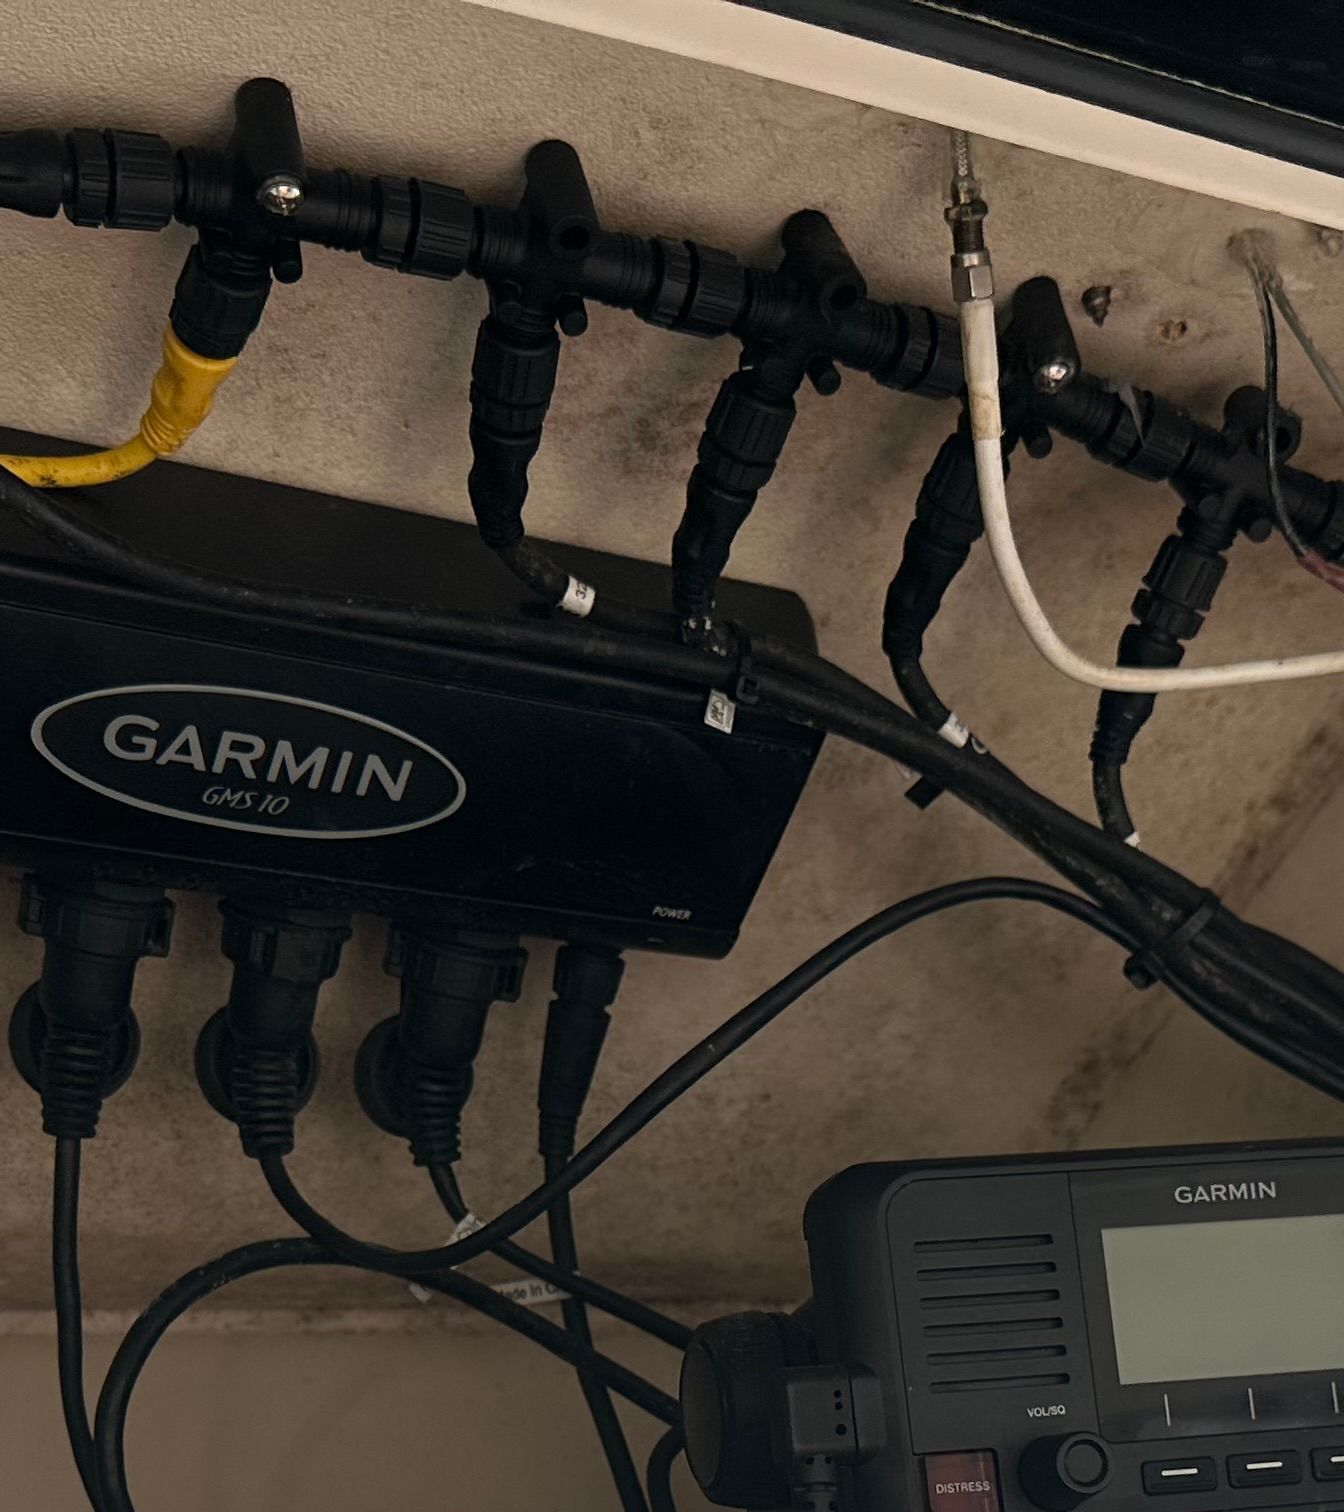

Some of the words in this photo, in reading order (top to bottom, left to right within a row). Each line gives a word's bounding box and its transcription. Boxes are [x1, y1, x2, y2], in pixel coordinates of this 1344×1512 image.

[103, 714, 413, 802] GARMIN
[202, 786, 260, 810] GMS
[258, 795, 290, 816] 10
[652, 906, 692, 920] POWER
[1174, 1181, 1276, 1203] GARMIN
[1027, 1405, 1066, 1417] VOL/SQ
[936, 1481, 991, 1494] DISTRESS
